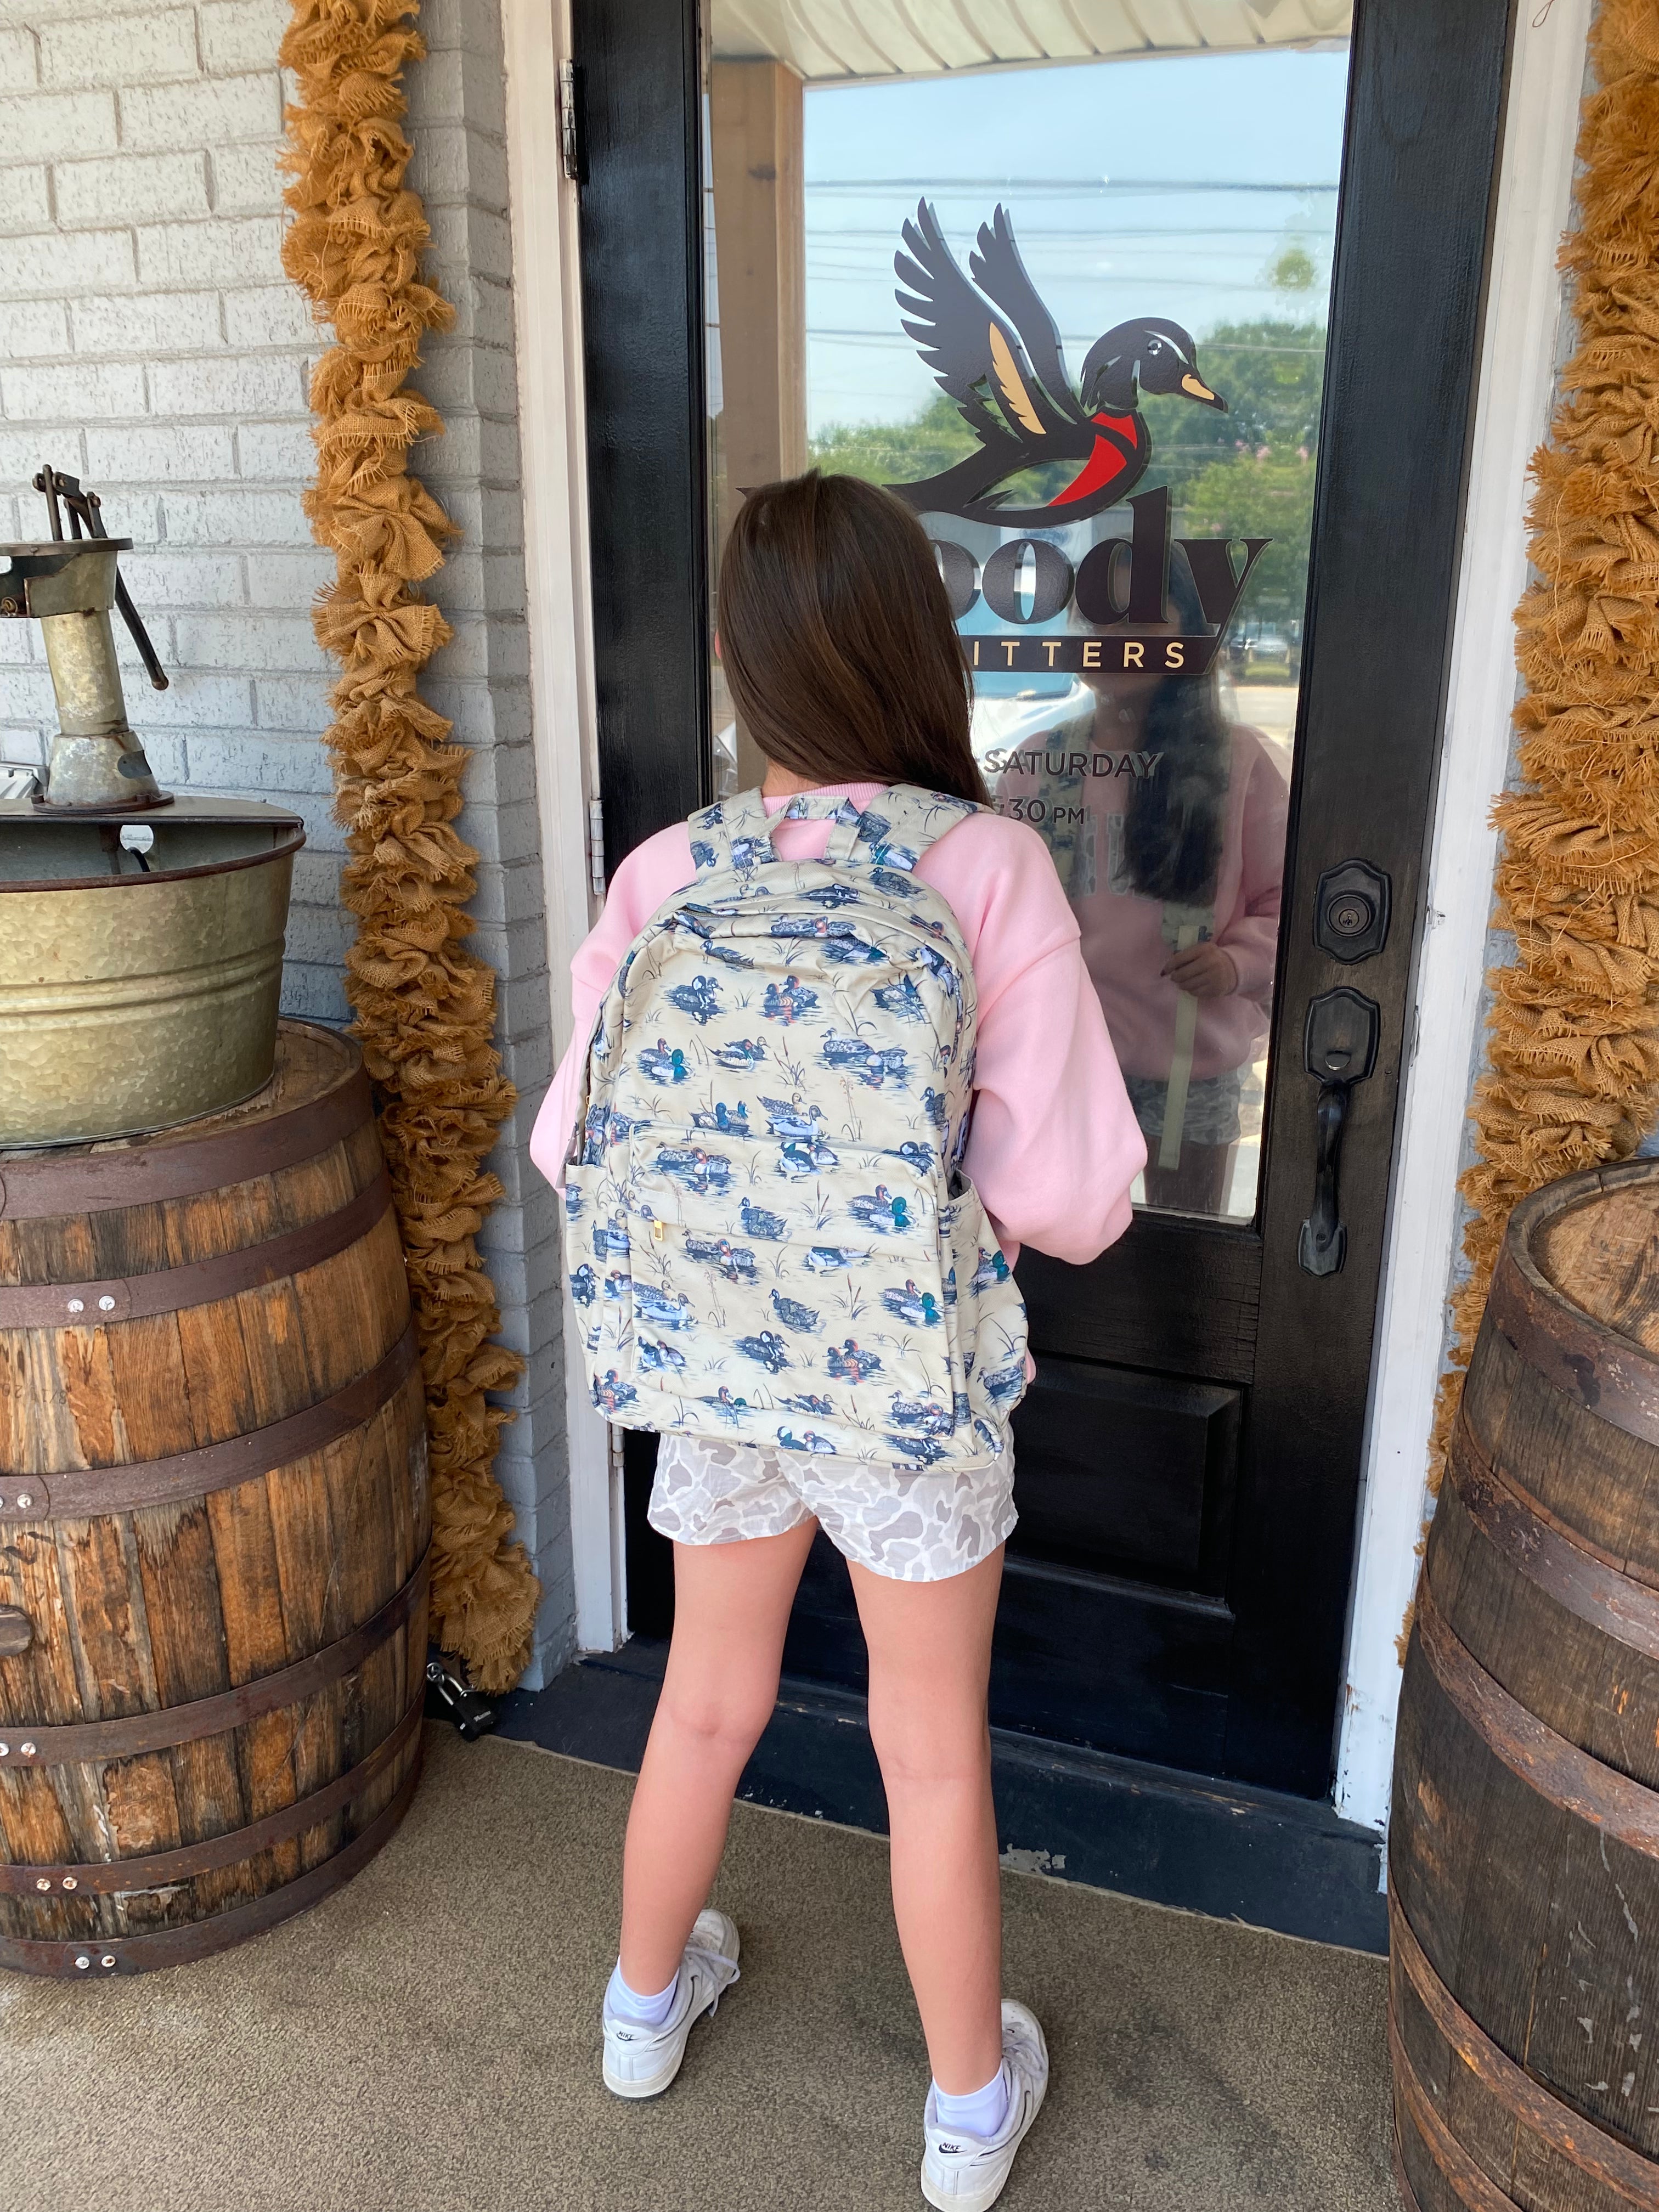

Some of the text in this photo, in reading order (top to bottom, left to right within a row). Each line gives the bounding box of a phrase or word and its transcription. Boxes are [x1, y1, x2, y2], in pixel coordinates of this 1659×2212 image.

[973, 641, 1184, 668] ITTERS
[984, 749, 1158, 778] SATURDAY
[1053, 807, 1084, 825] PM
[618, 2030, 635, 2039] NIKE
[943, 2142, 961, 2151] NIKE
